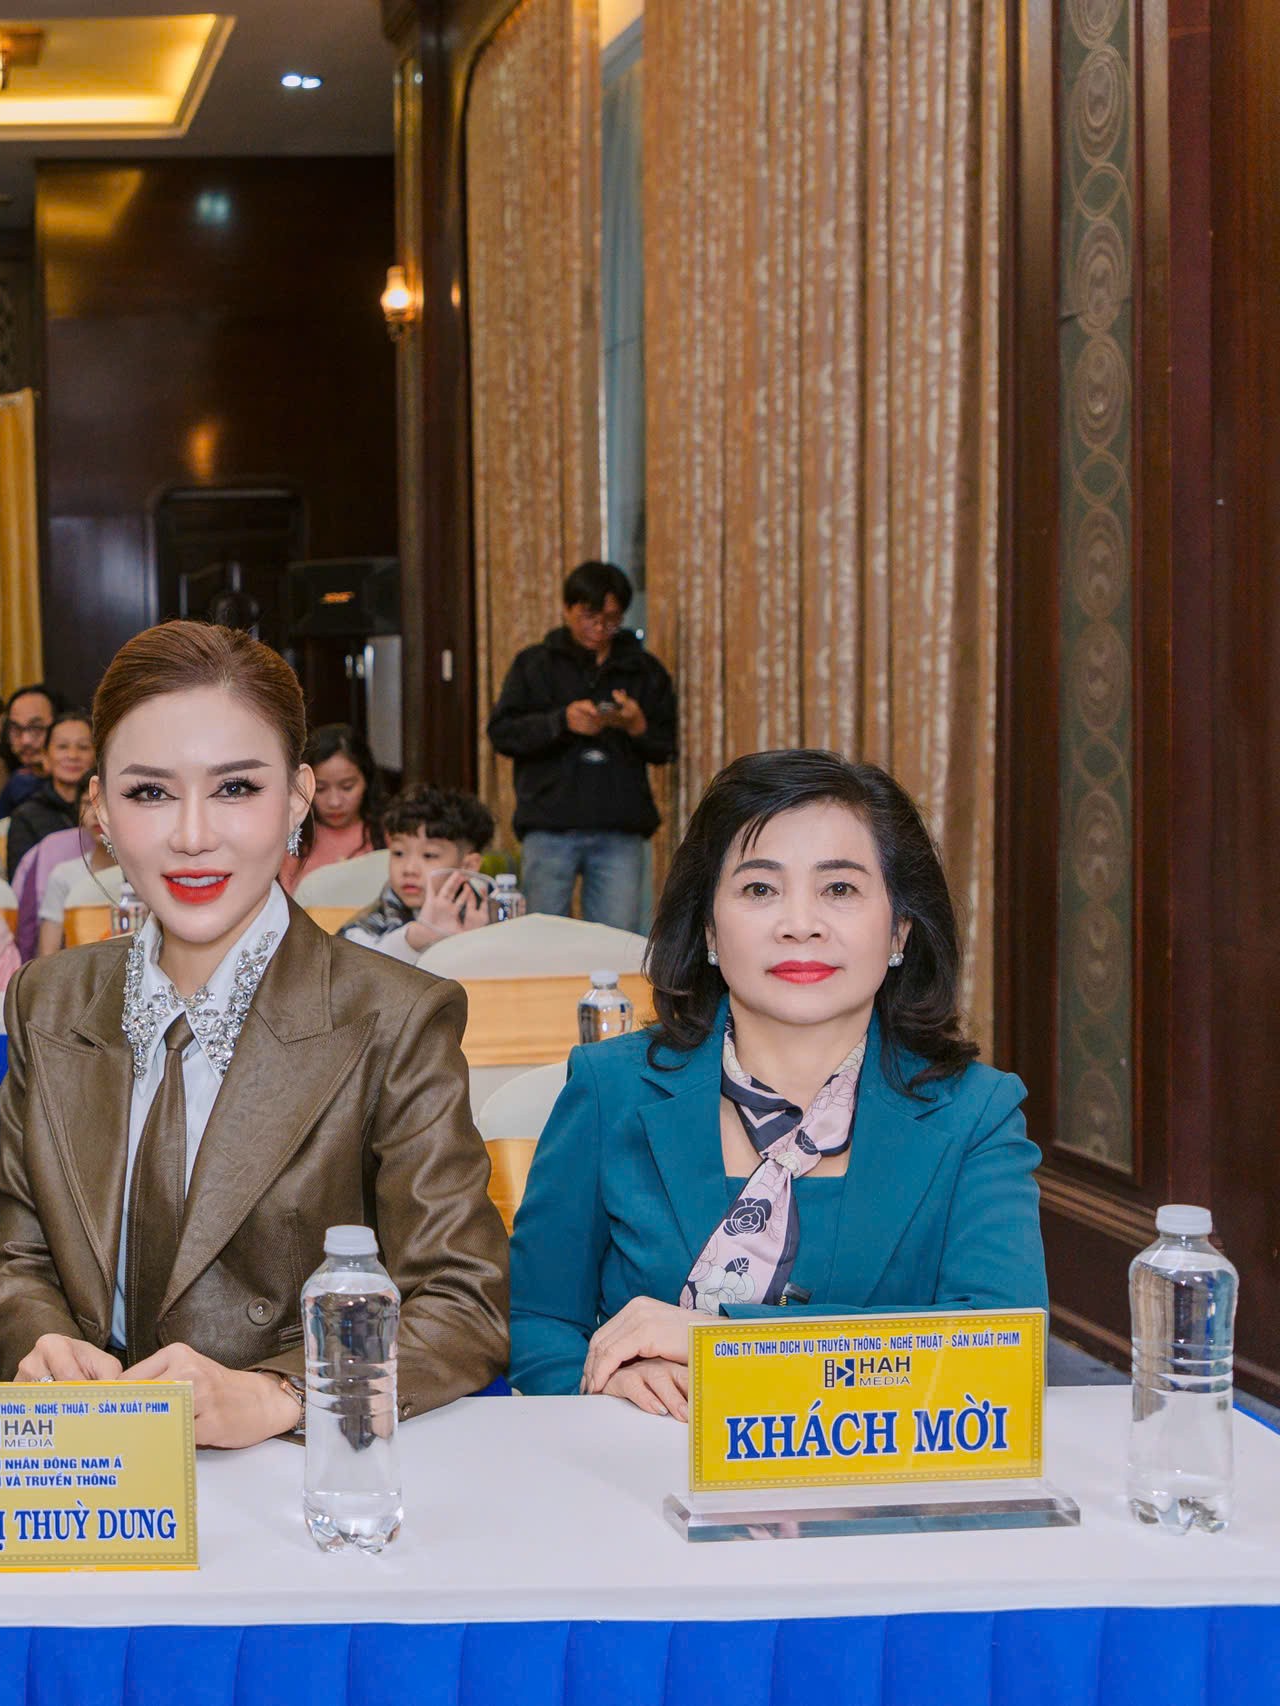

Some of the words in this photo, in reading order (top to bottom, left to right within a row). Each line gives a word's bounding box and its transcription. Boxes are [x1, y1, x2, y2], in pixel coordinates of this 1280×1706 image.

[715, 1341, 739, 1356] CÔNG
[742, 1343, 752, 1355] TY
[755, 1342, 777, 1355] TNHH
[780, 1341, 801, 1357] DỊCH
[803, 1340, 814, 1356] VỤ
[817, 1336, 850, 1352] TRUYỀN
[854, 1336, 882, 1351] THÔNG
[890, 1334, 913, 1351] NGHỆ
[916, 1334, 943, 1351] THUẬT
[952, 1330, 969, 1347] SẢN
[972, 1329, 995, 1346] XUẤT
[997, 1332, 1020, 1345] PHIM
[860, 1356, 911, 1374] HAH
[860, 1376, 911, 1386] MEDIA
[35, 1403, 58, 1416] NGHỆ
[62, 1402, 89, 1416] THUẬT
[99, 1400, 117, 1413] SẢN
[120, 1400, 143, 1413] XUẤT
[146, 1402, 169, 1413] PHIM
[4, 1419, 53, 1436] HAH
[726, 1400, 898, 1460] KHÁCH
[914, 1394, 1008, 1453] MỜI
[4, 1439, 54, 1448] MEDIA
[5, 1457, 39, 1470] NHÂN
[44, 1457, 77, 1469] ĐÔNG
[81, 1459, 110, 1469] NAM
[114, 1456, 122, 1468] Á
[6, 1474, 21, 1486] VÀ
[25, 1473, 72, 1486] TRUYỀN
[76, 1474, 117, 1486] THÔNG
[14, 1500, 91, 1540] THUỲ
[98, 1509, 177, 1539] DUNG
